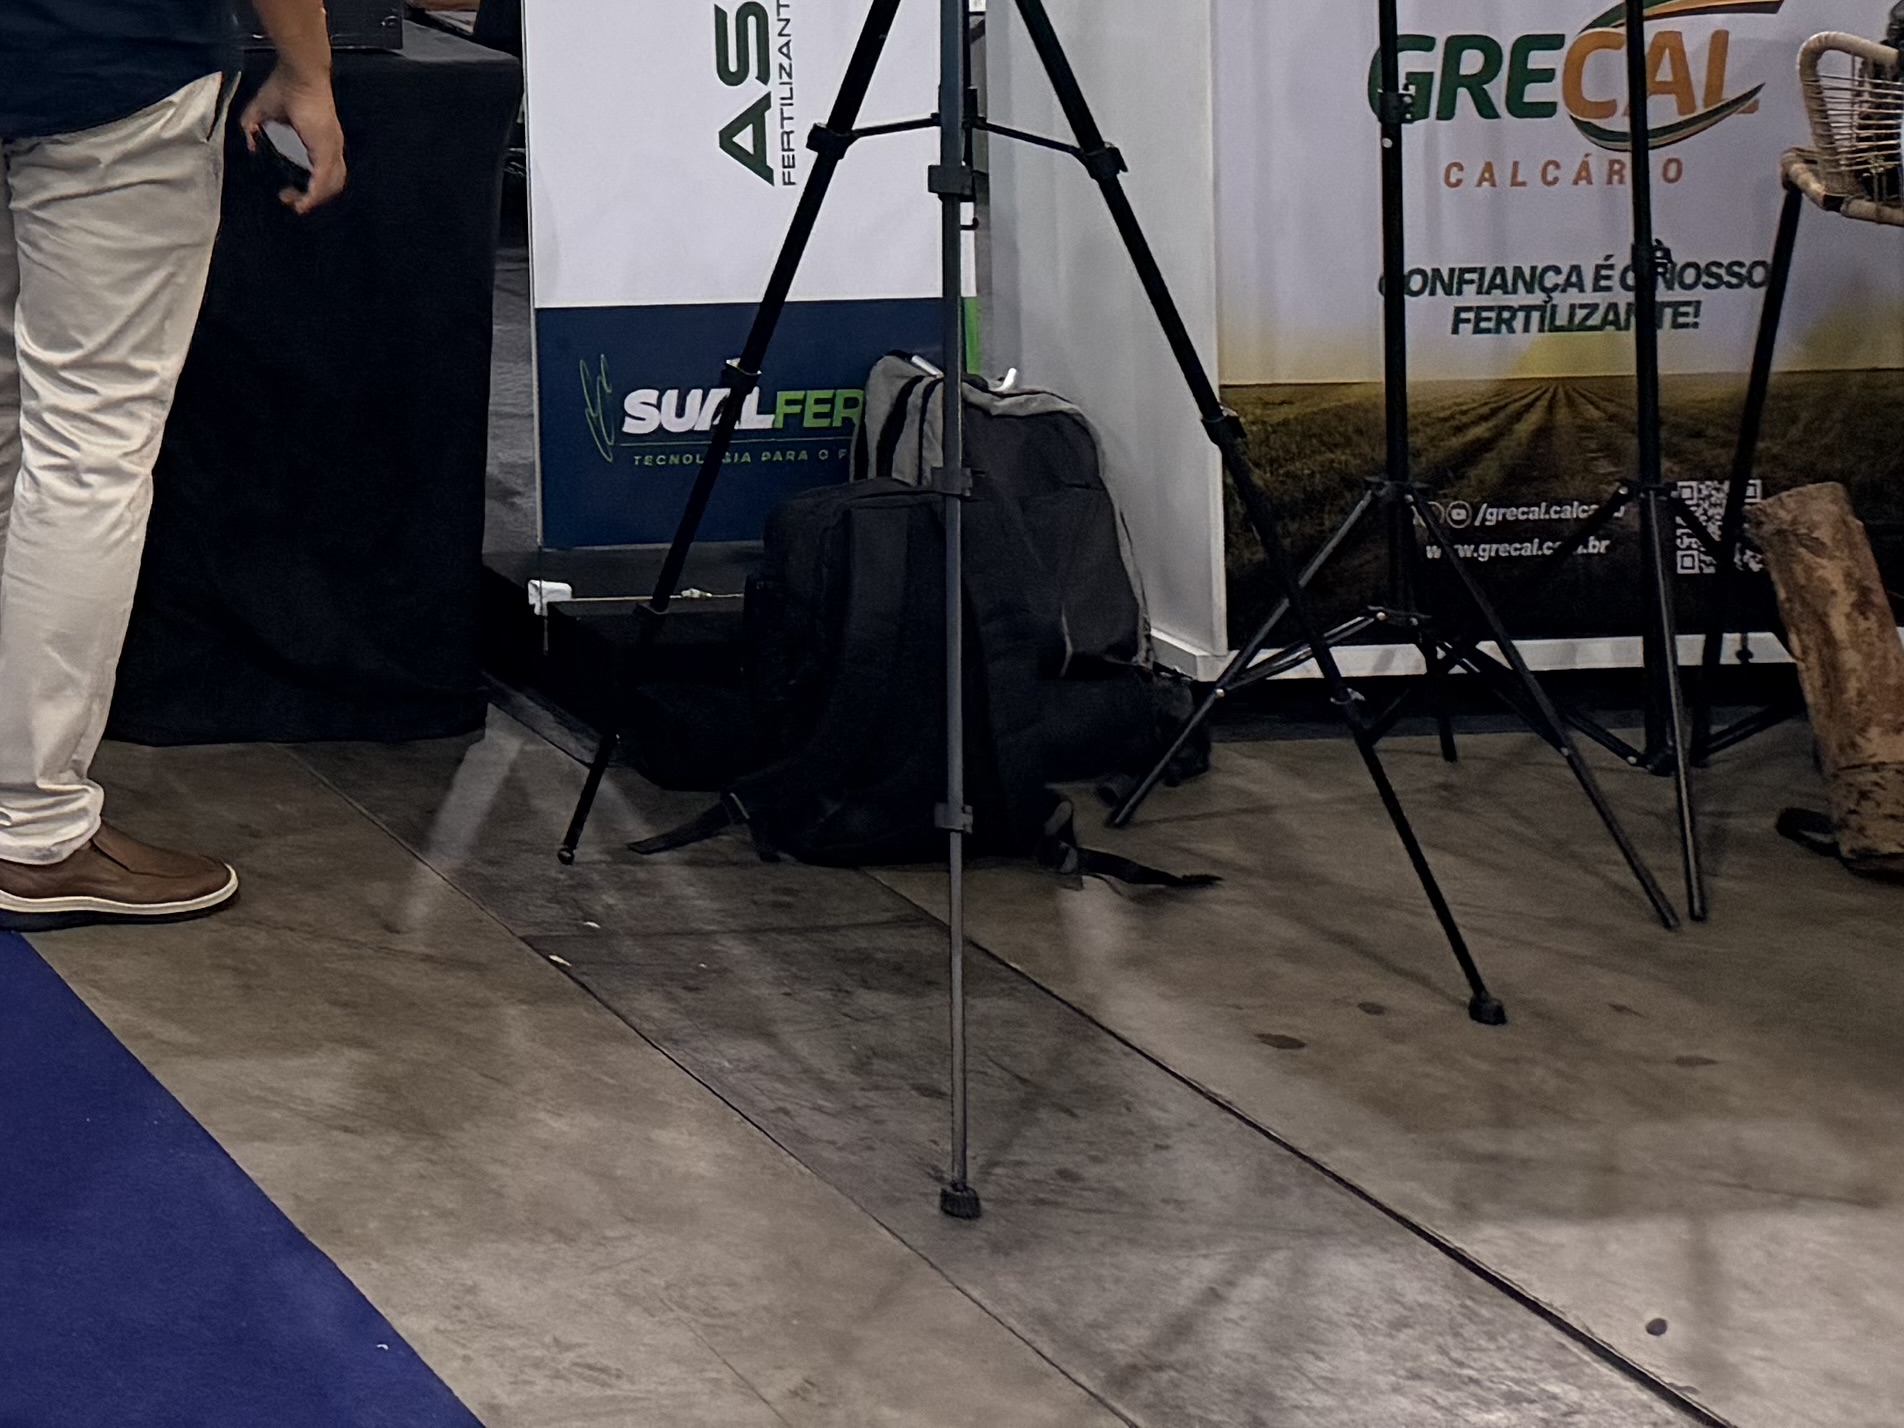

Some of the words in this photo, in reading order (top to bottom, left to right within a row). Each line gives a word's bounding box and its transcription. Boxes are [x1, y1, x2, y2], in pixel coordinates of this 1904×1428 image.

[1443, 152, 1684, 188] CALCÁRO
[1378, 263, 1587, 304] ONFIANÇA
[1592, 254, 1615, 292] É
